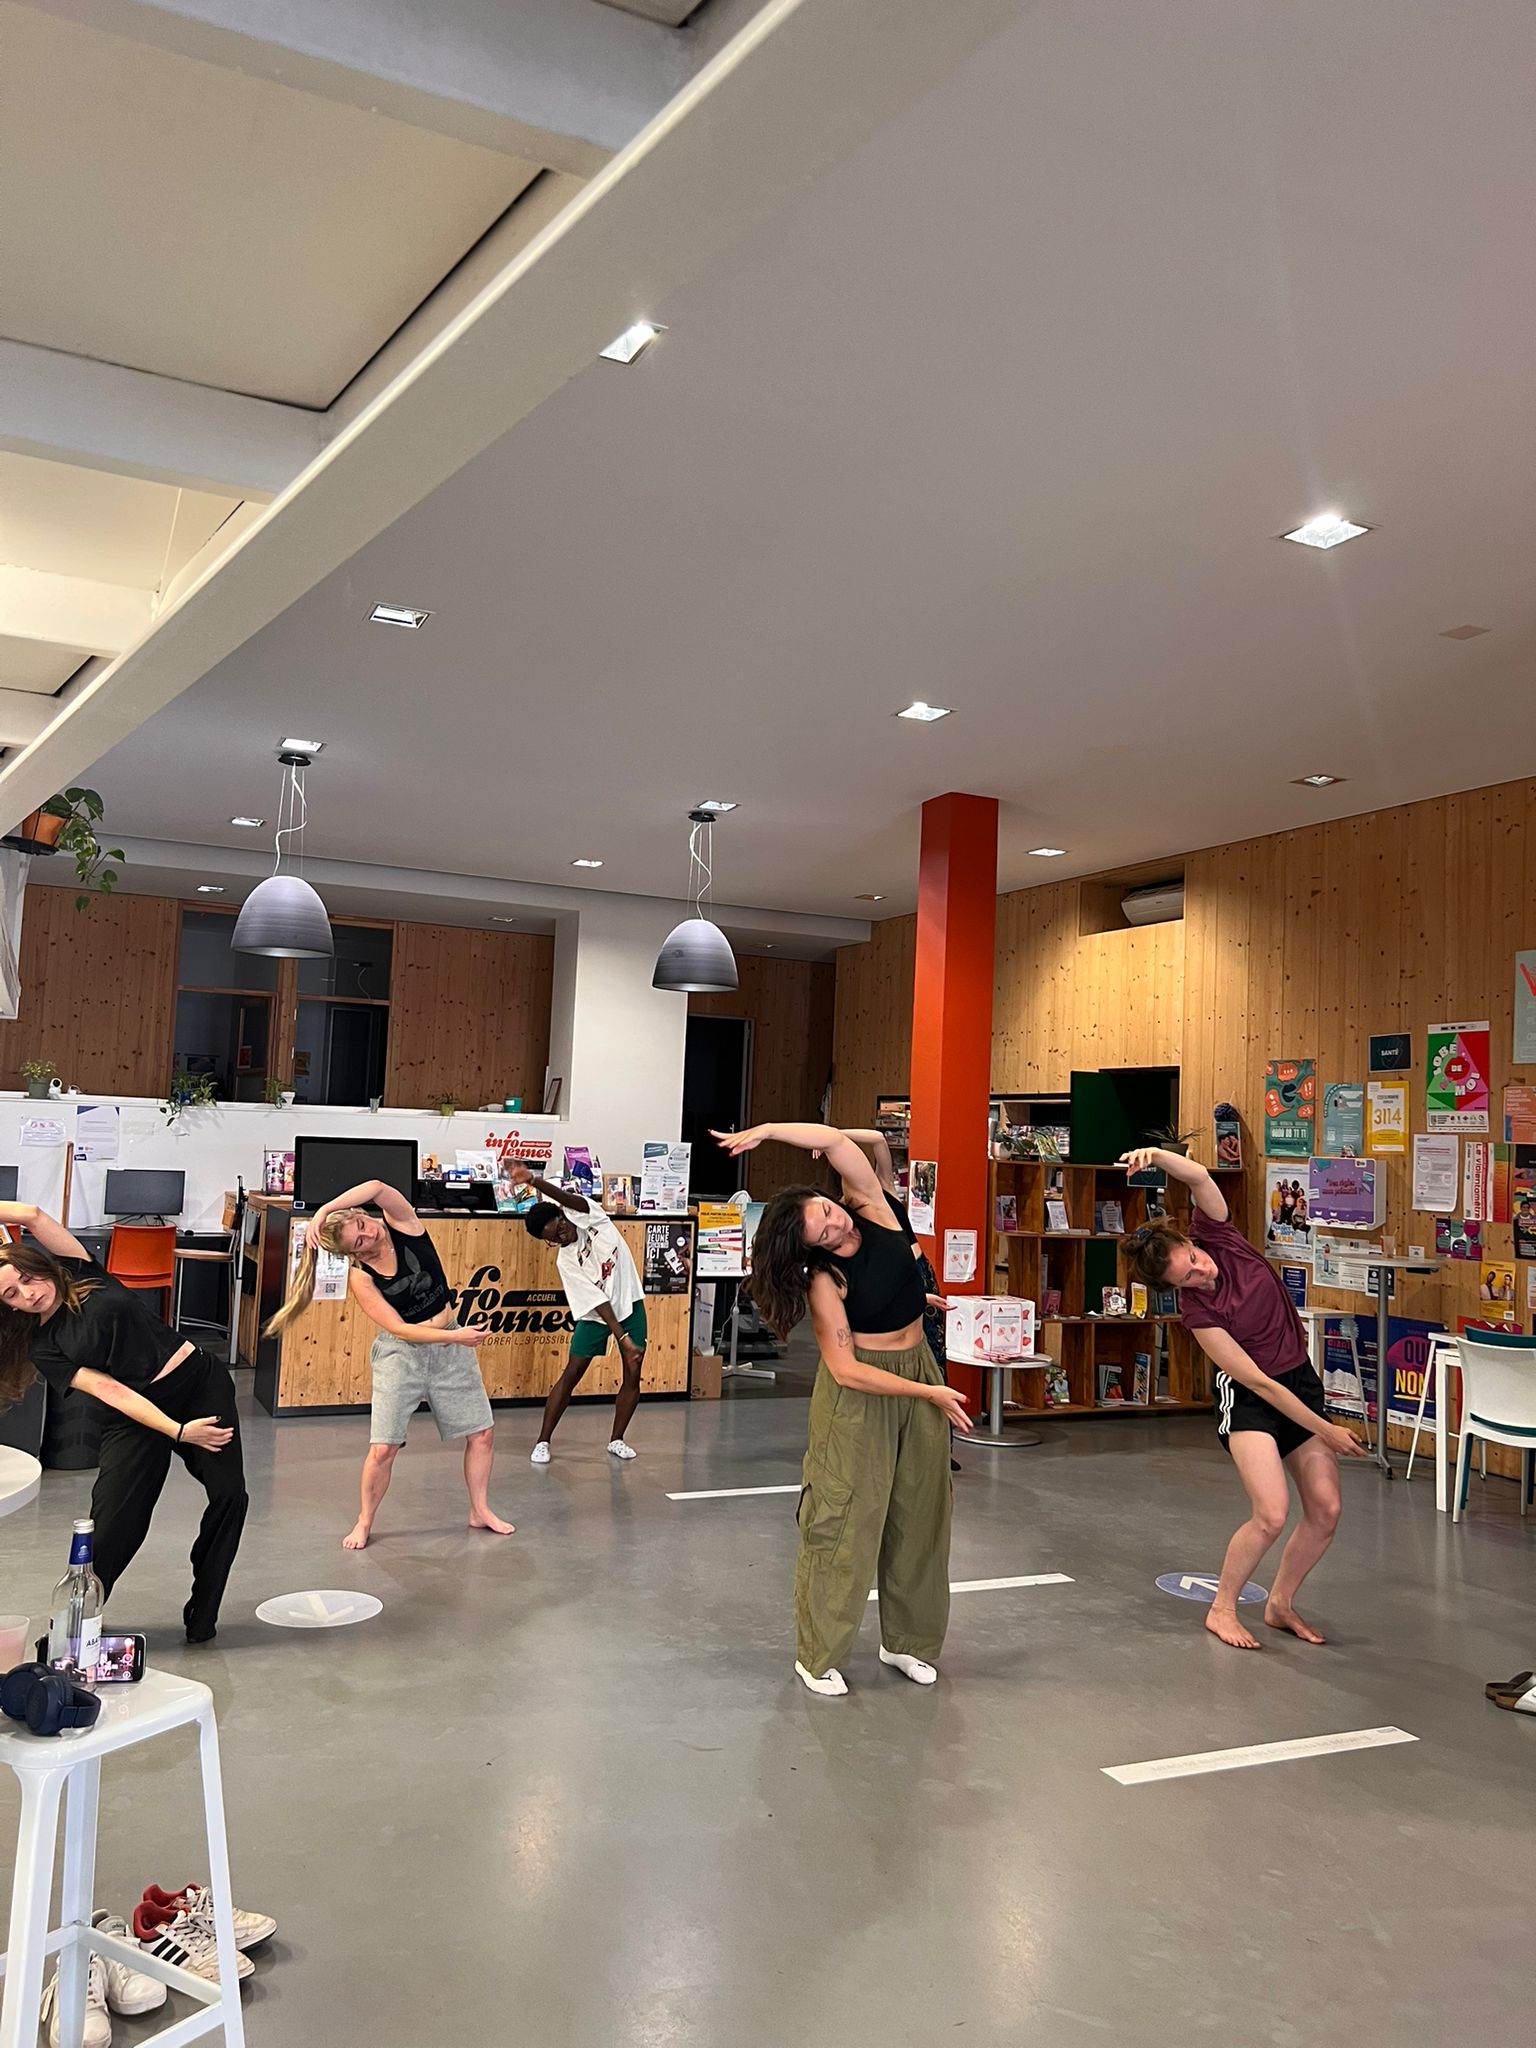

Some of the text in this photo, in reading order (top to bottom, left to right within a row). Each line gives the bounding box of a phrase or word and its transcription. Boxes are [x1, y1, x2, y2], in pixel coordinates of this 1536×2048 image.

[1451, 1064, 1462, 1072] DE
[1455, 1072, 1480, 1096] MOI
[1374, 1108, 1402, 1125] 3114
[1475, 1143, 1482, 1156] Le
[647, 1225, 670, 1234] CARTE
[647, 1234, 669, 1243] JEUNE
[646, 1248, 660, 1259] ICI
[526, 1293, 557, 1302] ACCUEIL
[481, 1337, 512, 1346] LORER
[533, 1335, 570, 1345] POSSIBL
[1404, 1339, 1430, 1366] OU
